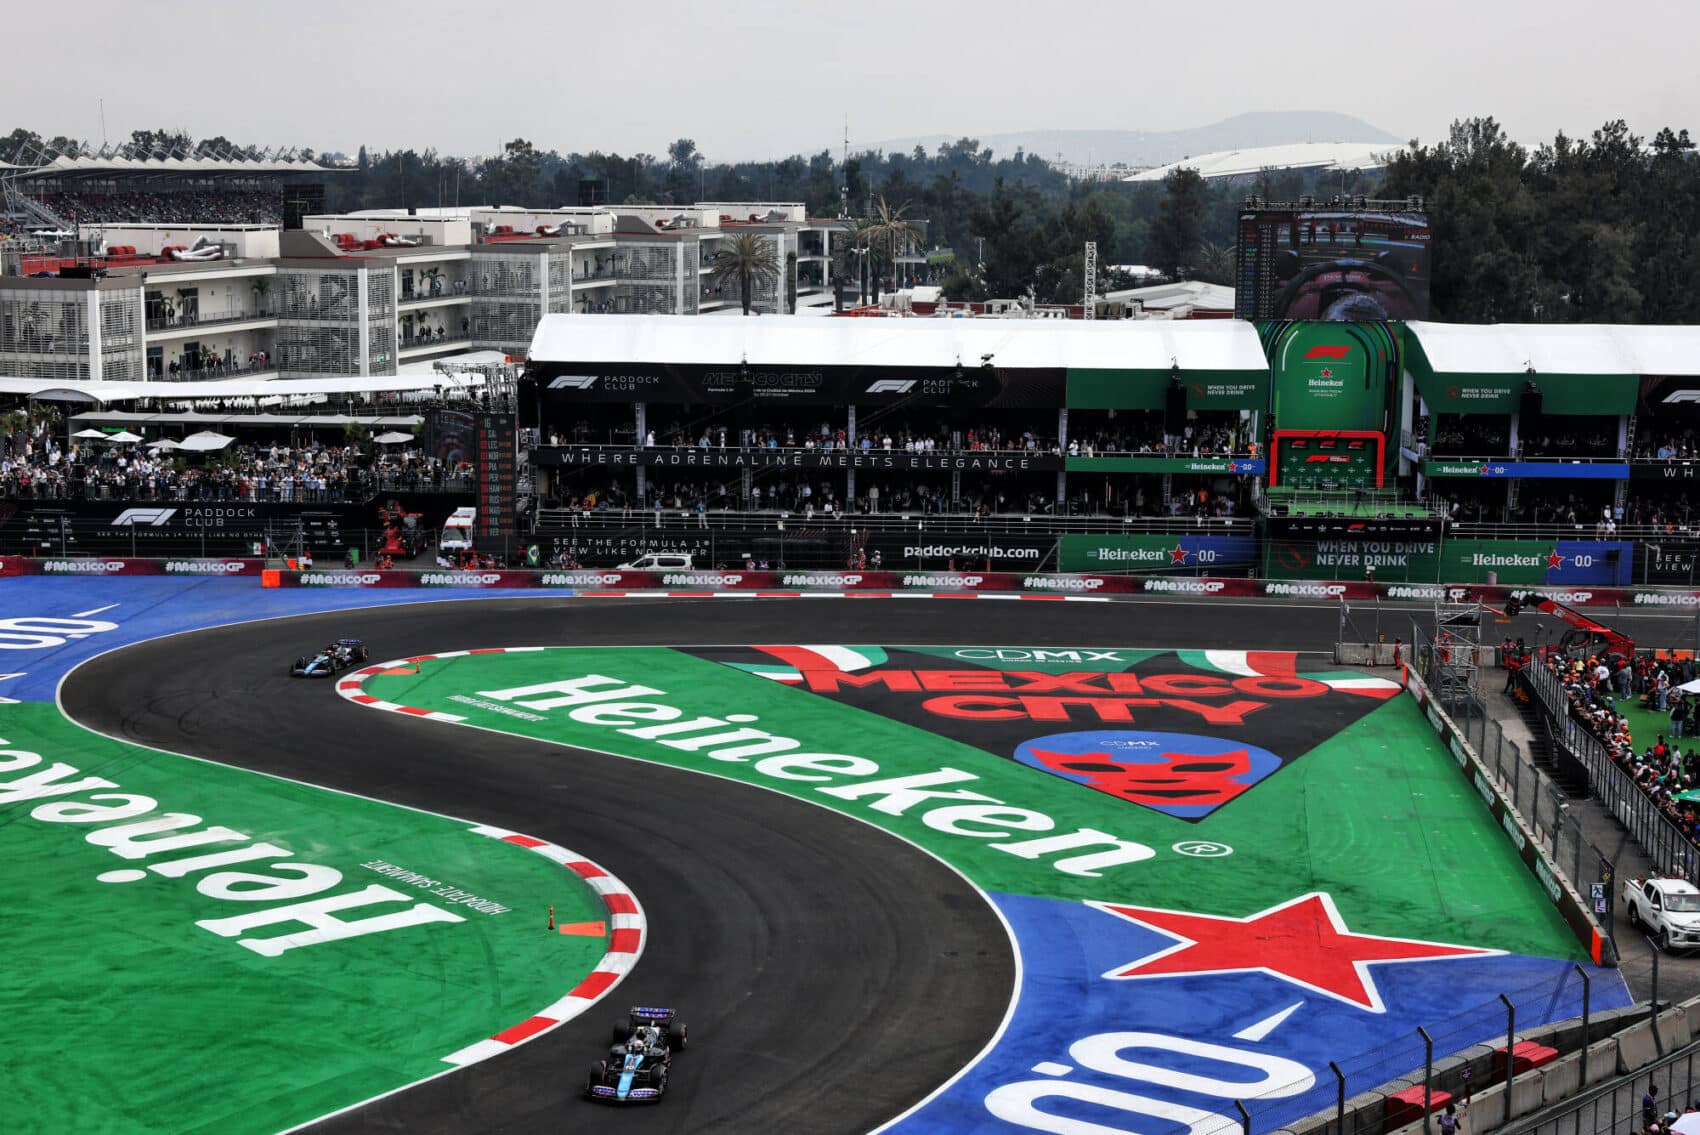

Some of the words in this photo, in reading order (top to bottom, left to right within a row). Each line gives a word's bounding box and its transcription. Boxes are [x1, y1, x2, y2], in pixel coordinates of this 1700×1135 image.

[604, 375, 659, 383] PADDOCK
[562, 453, 638, 464] WHERE
[655, 454, 801, 465] ADRENALINE
[819, 456, 893, 467] MEETS
[911, 458, 1029, 469] ELEGANCE
[1191, 463, 1225, 471] Heineken
[1443, 466, 1478, 474] Heineken
[185, 508, 255, 518] PADDOCK
[185, 517, 224, 527] CLUB
[587, 538, 612, 546] THE
[621, 539, 687, 547] FORMULA
[1317, 540, 1353, 553] WHEN
[1361, 541, 1390, 554] YOU
[1395, 542, 1434, 555] DRIVE
[597, 547, 627, 555] LIKE
[1098, 547, 1165, 561] Heineken
[1198, 550, 1215, 562] 0.0
[1317, 554, 1359, 566] NEVER
[1364, 555, 1407, 566] DRINK
[1473, 553, 1540, 566] Heineken
[1574, 555, 1592, 567] 0.0
[44, 561, 125, 572] #MexicoGP
[165, 562, 245, 573] #MexicoGP
[1655, 563, 1691, 571] VIEW
[300, 573, 381, 585] #MexicoGP
[420, 573, 501, 585] #MexicoGP
[542, 574, 622, 585] #MexicoGP
[662, 574, 743, 585] #MexicoGP
[782, 575, 863, 585] #MexicoGP
[902, 576, 983, 586] #MexicoGP
[1023, 577, 1104, 588] #MexicoGP
[1144, 579, 1225, 592] #MexicoGP
[1265, 583, 1346, 596] #MexicoGP
[954, 649, 1127, 662] CDMX
[800, 670, 1329, 699] MEXICO
[922, 694, 1273, 726] CITY
[474, 674, 1156, 878] Heineken
